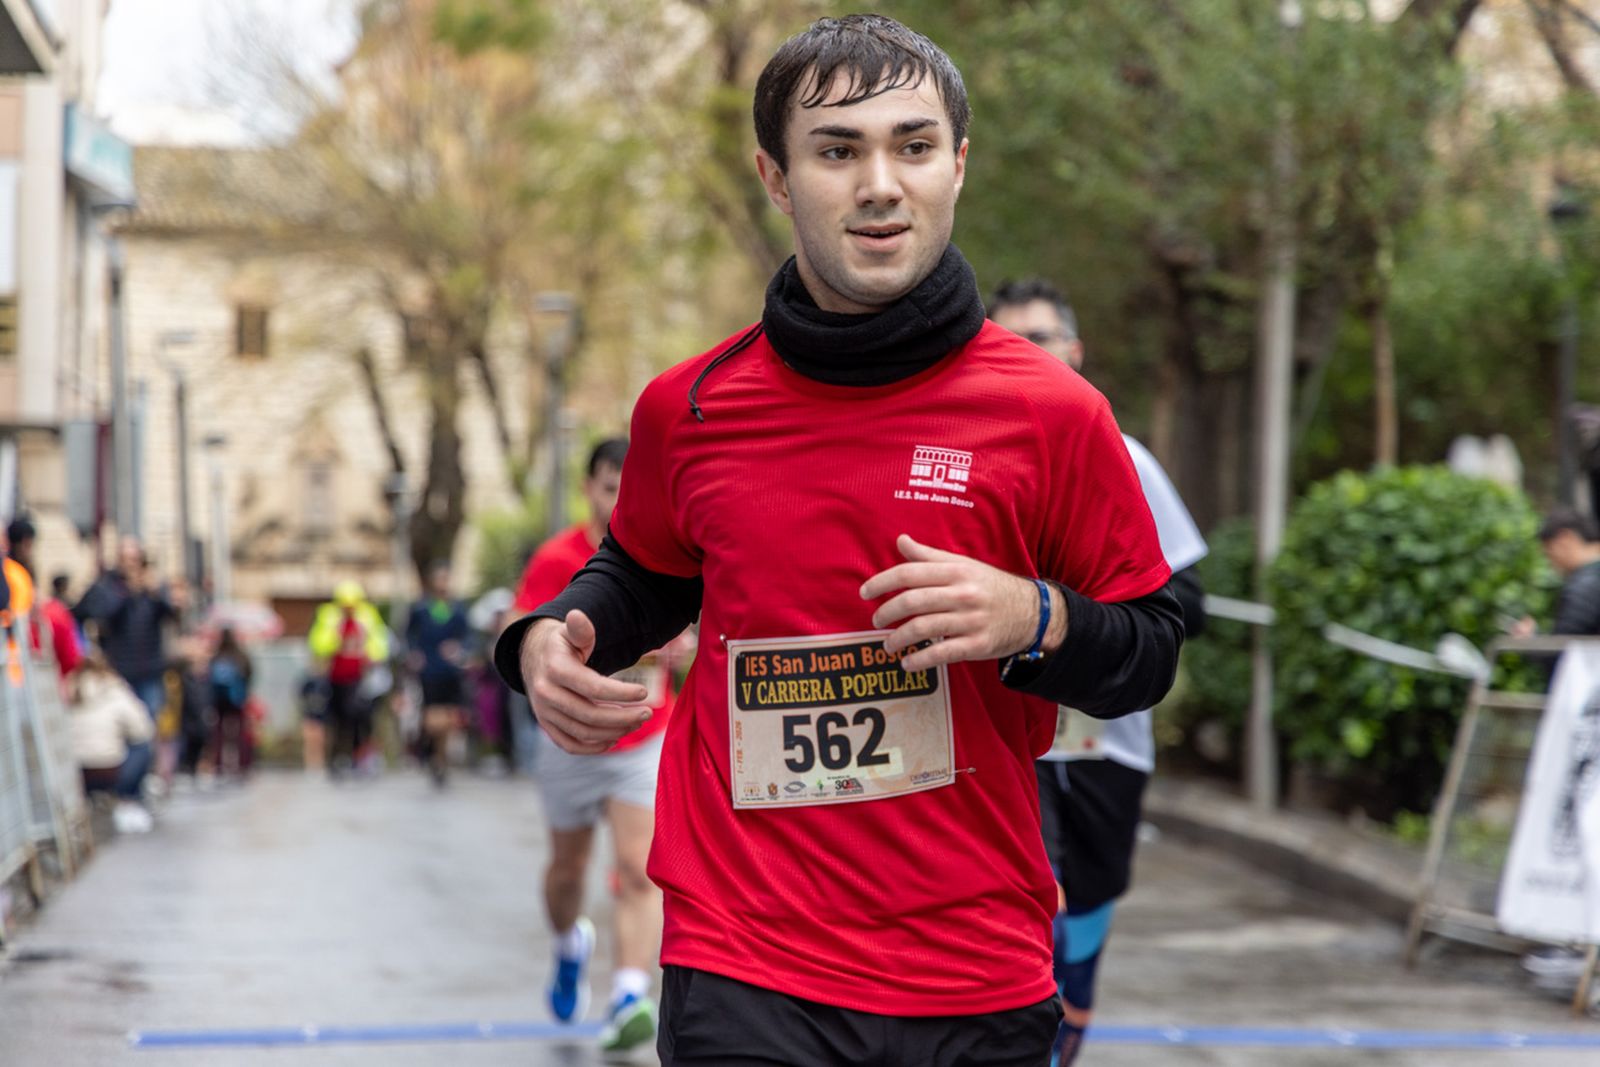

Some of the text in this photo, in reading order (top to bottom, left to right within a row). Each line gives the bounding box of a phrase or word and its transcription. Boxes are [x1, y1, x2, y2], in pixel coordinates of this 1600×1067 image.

[914, 491, 929, 501] San
[930, 494, 950, 504] Juan
[951, 496, 974, 508] Bosco
[745, 654, 768, 677] IES
[772, 654, 804, 676] San
[810, 651, 856, 673] Juan
[741, 670, 929, 705] V CARRERA POPULAR
[782, 708, 891, 774] 562
